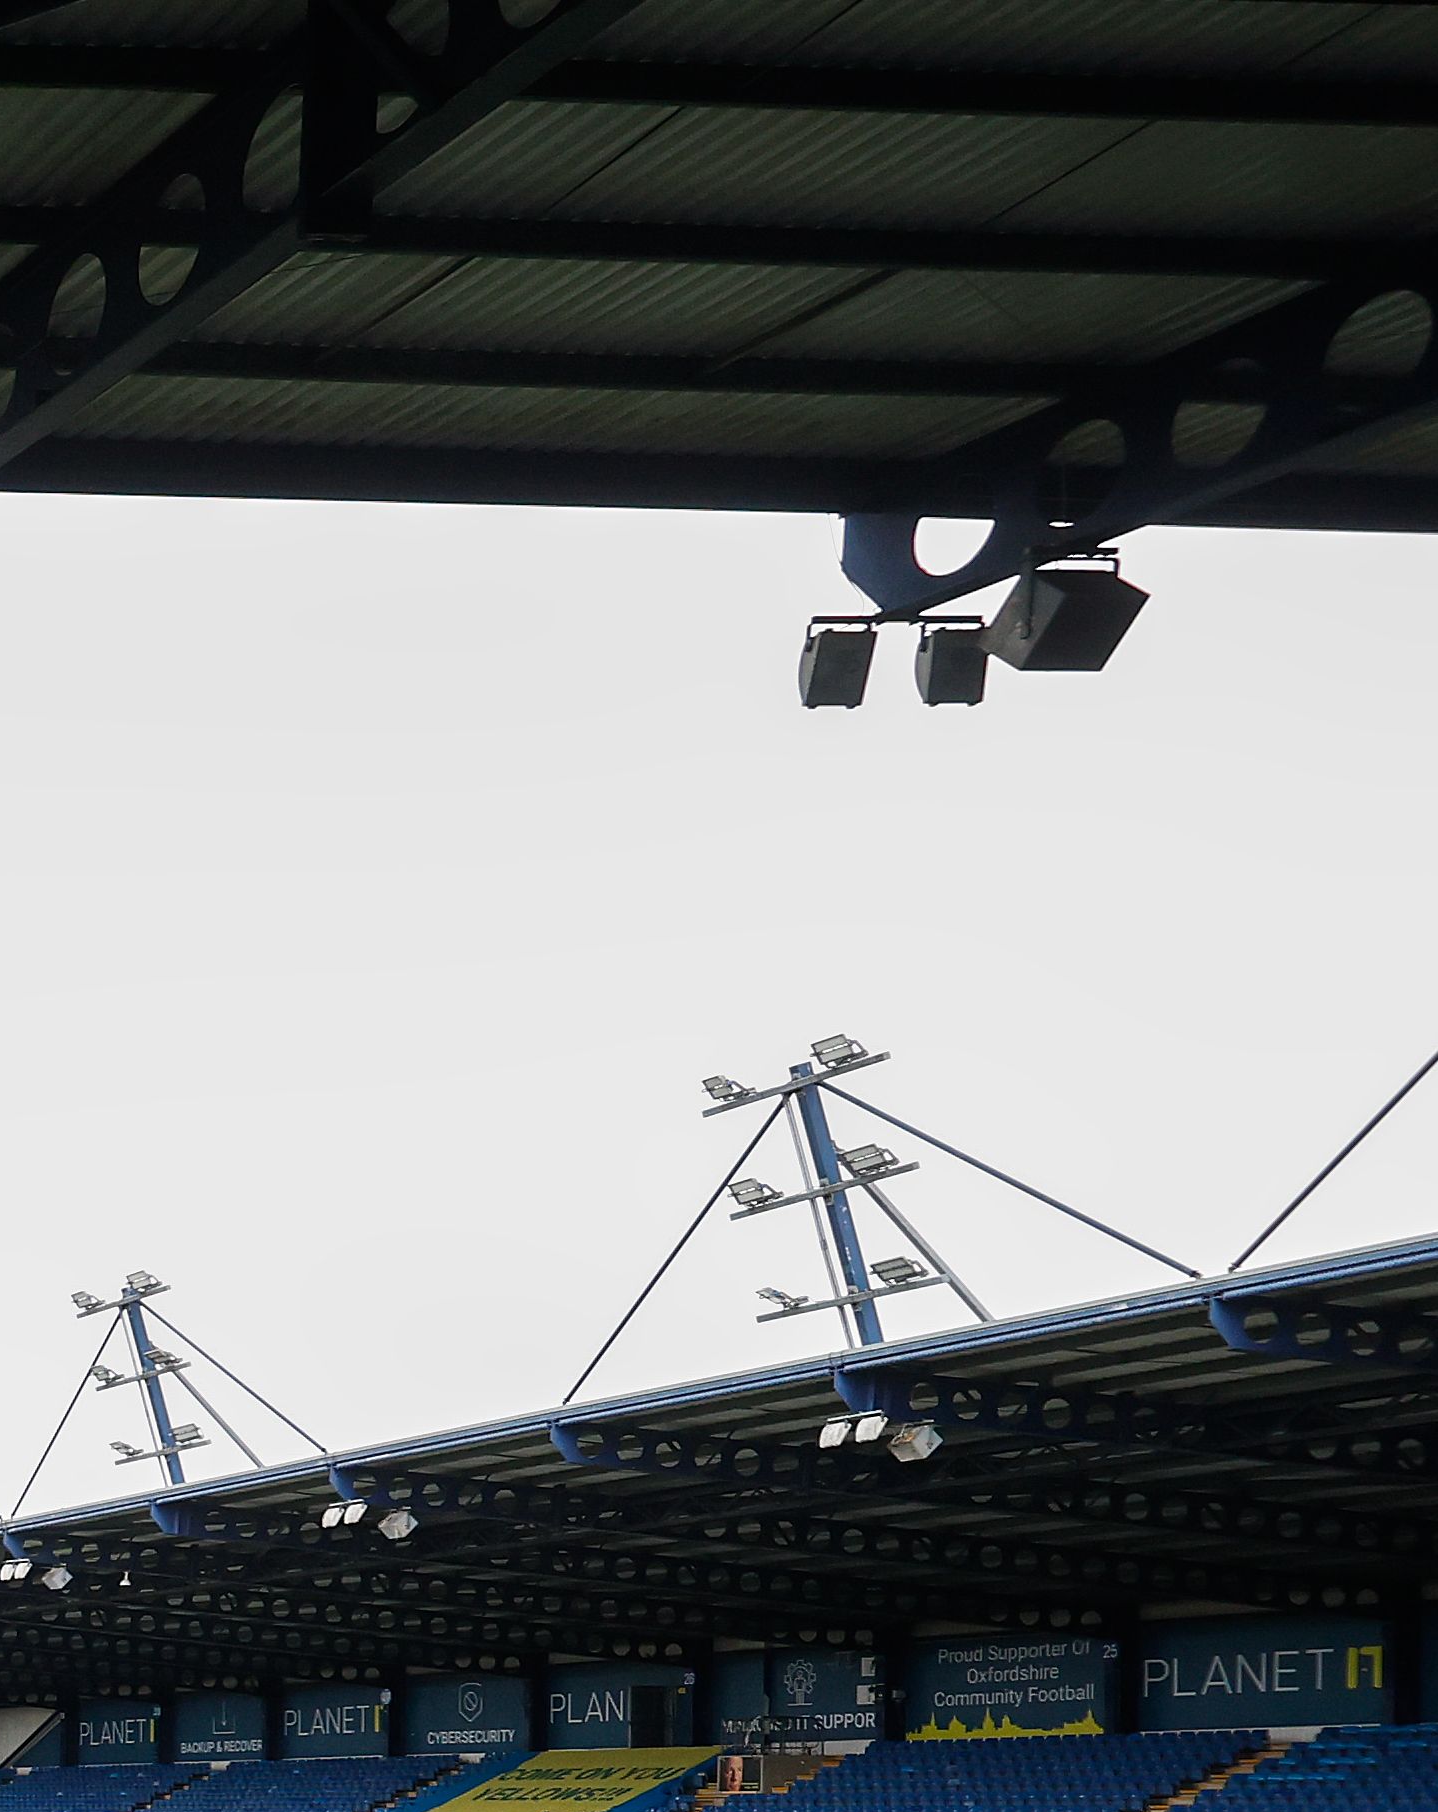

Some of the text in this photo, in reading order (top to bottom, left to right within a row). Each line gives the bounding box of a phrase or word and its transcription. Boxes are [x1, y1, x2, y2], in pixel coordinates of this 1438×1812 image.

[938, 1648, 983, 1664] Proud
[988, 1643, 1067, 1663] Supporter
[967, 1665, 1059, 1684] Oxfordshire
[1143, 1649, 1335, 1697] PLANET
[934, 1683, 1094, 1707] Community Football
[549, 1690, 625, 1725] PLAN
[284, 1705, 370, 1736] PLANET
[813, 1712, 876, 1730] SUPPOR
[79, 1718, 147, 1746] PLANET
[427, 1729, 515, 1745] CYBERSECURITY
[180, 1741, 215, 1753] BACKUP
[224, 1739, 263, 1752] RECOVER
[621, 1767, 685, 1780] YOU
